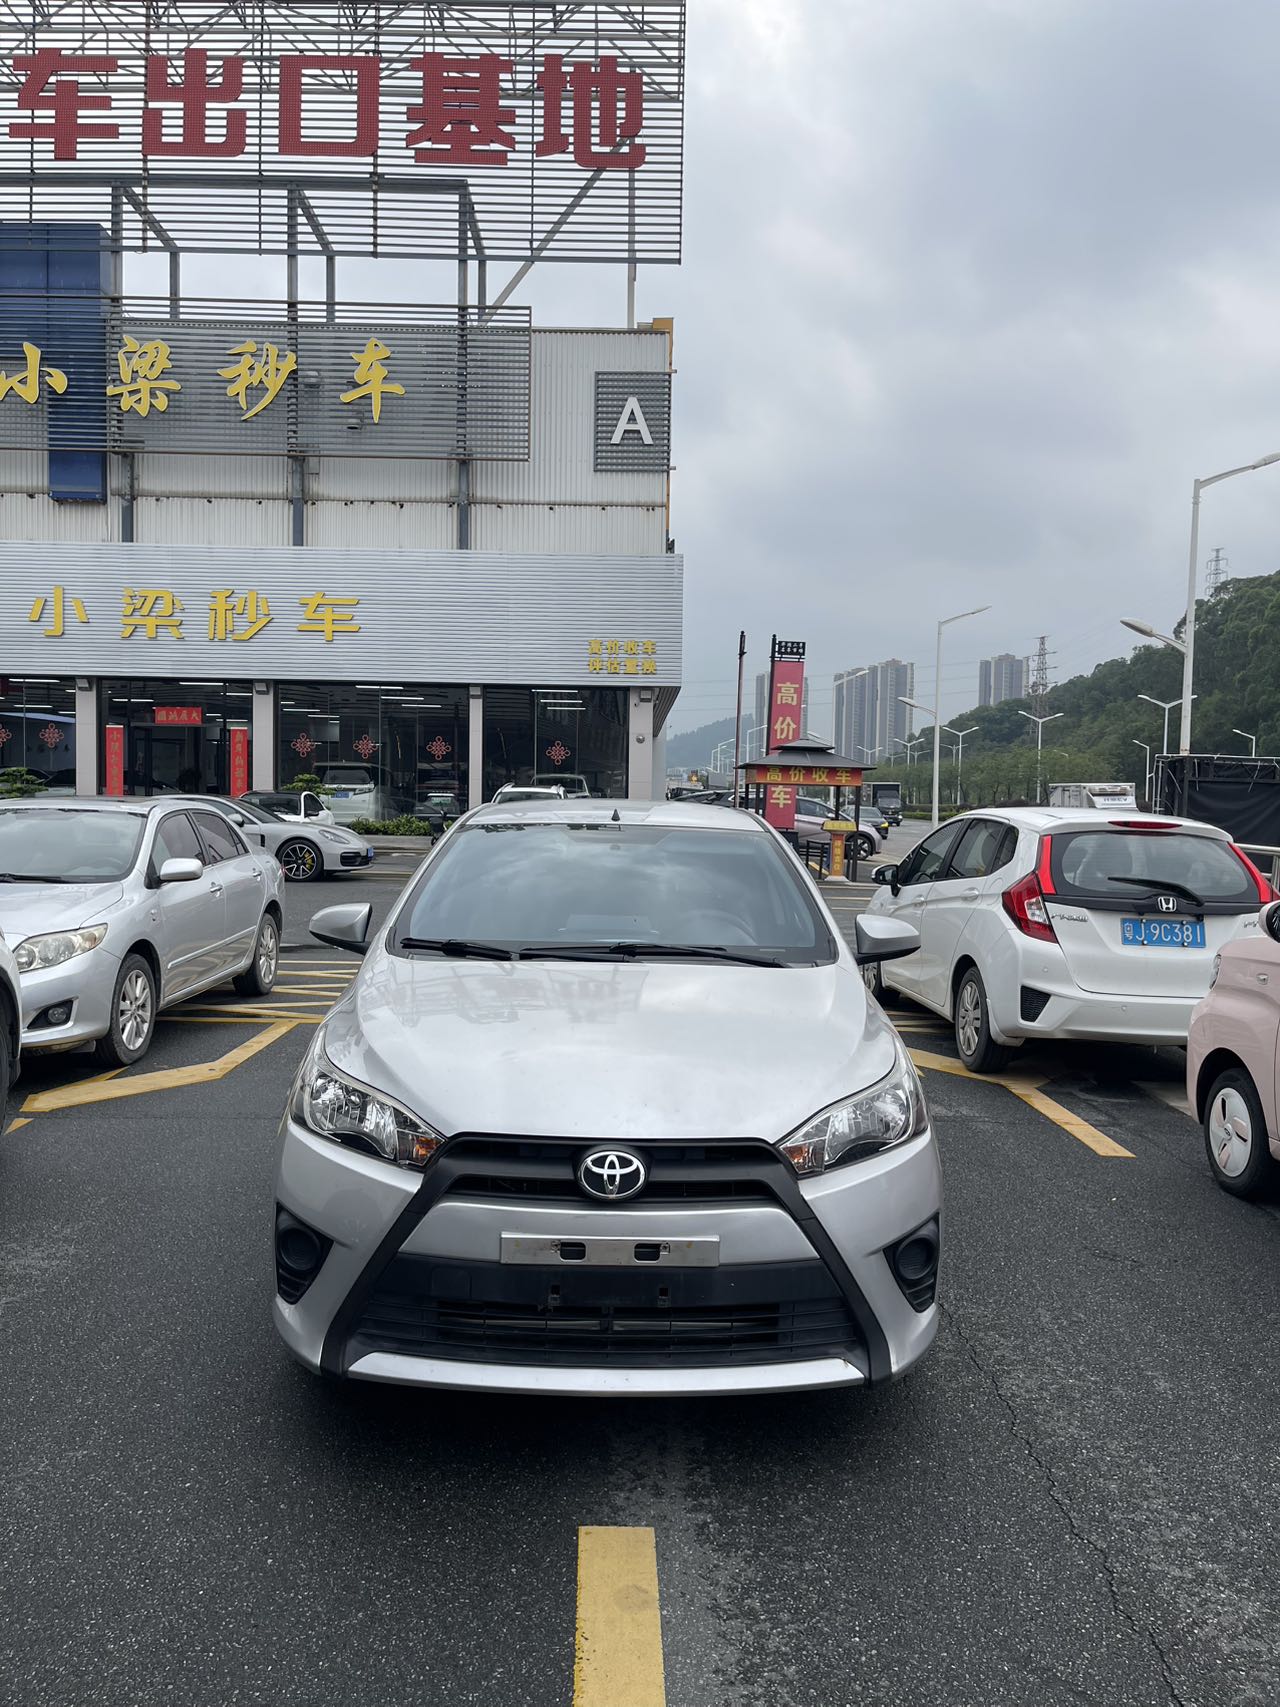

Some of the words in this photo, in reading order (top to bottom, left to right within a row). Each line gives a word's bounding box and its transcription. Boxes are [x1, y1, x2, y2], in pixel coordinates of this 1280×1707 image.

[9, 48, 646, 168] 车出口基地
[0, 335, 405, 424] 小梁秒车
[609, 396, 654, 445] A
[28, 585, 361, 642] 小梁秒车
[588, 639, 657, 656] 高价收车
[766, 766, 852, 783] 高价收车
